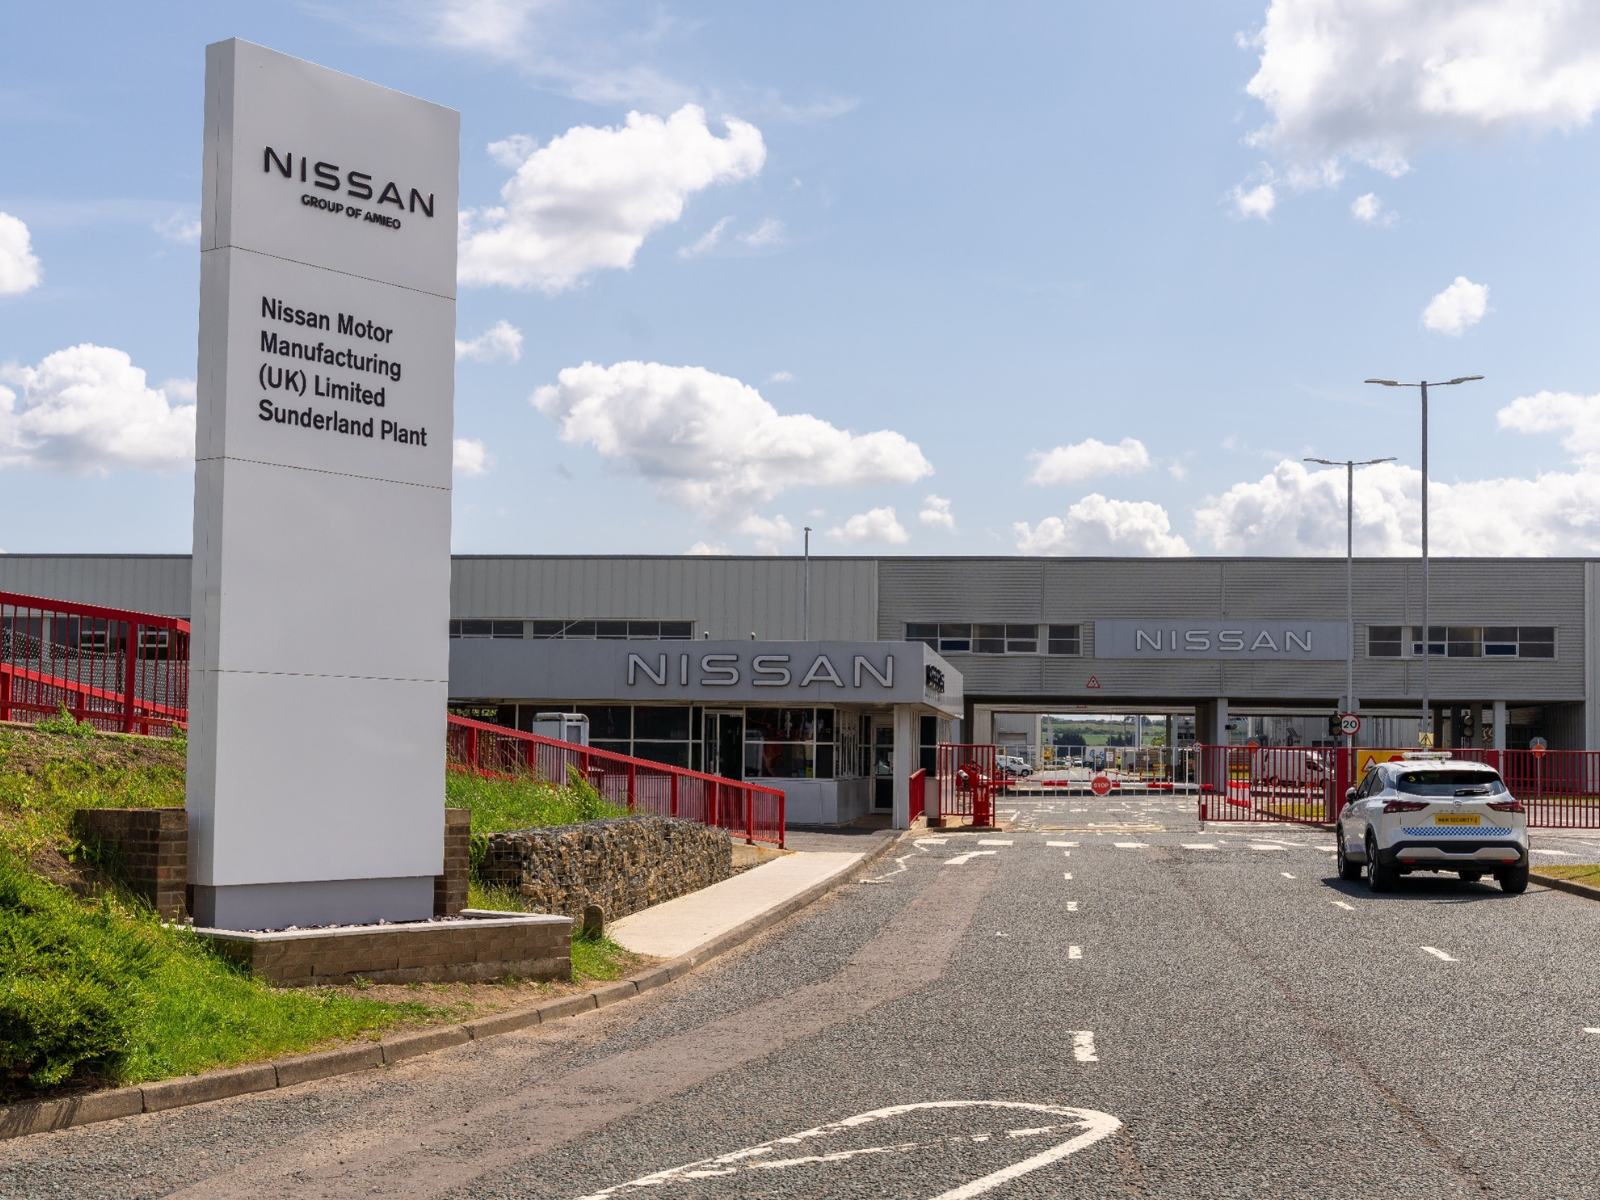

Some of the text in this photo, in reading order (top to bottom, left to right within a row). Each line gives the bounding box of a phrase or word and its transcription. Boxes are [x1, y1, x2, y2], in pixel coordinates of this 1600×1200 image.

[264, 146, 434, 218] NISSAN
[301, 194, 402, 230] GROUP OF AMIEO
[261, 296, 393, 343] Nissan Motor
[260, 330, 401, 382] Manufacturing
[259, 363, 386, 407] (UK) Limited
[258, 399, 427, 447] Sunderland Plant
[1135, 629, 1312, 652] NISSAN
[627, 653, 894, 688] NISSAN
[1343, 720, 1357, 729] 20
